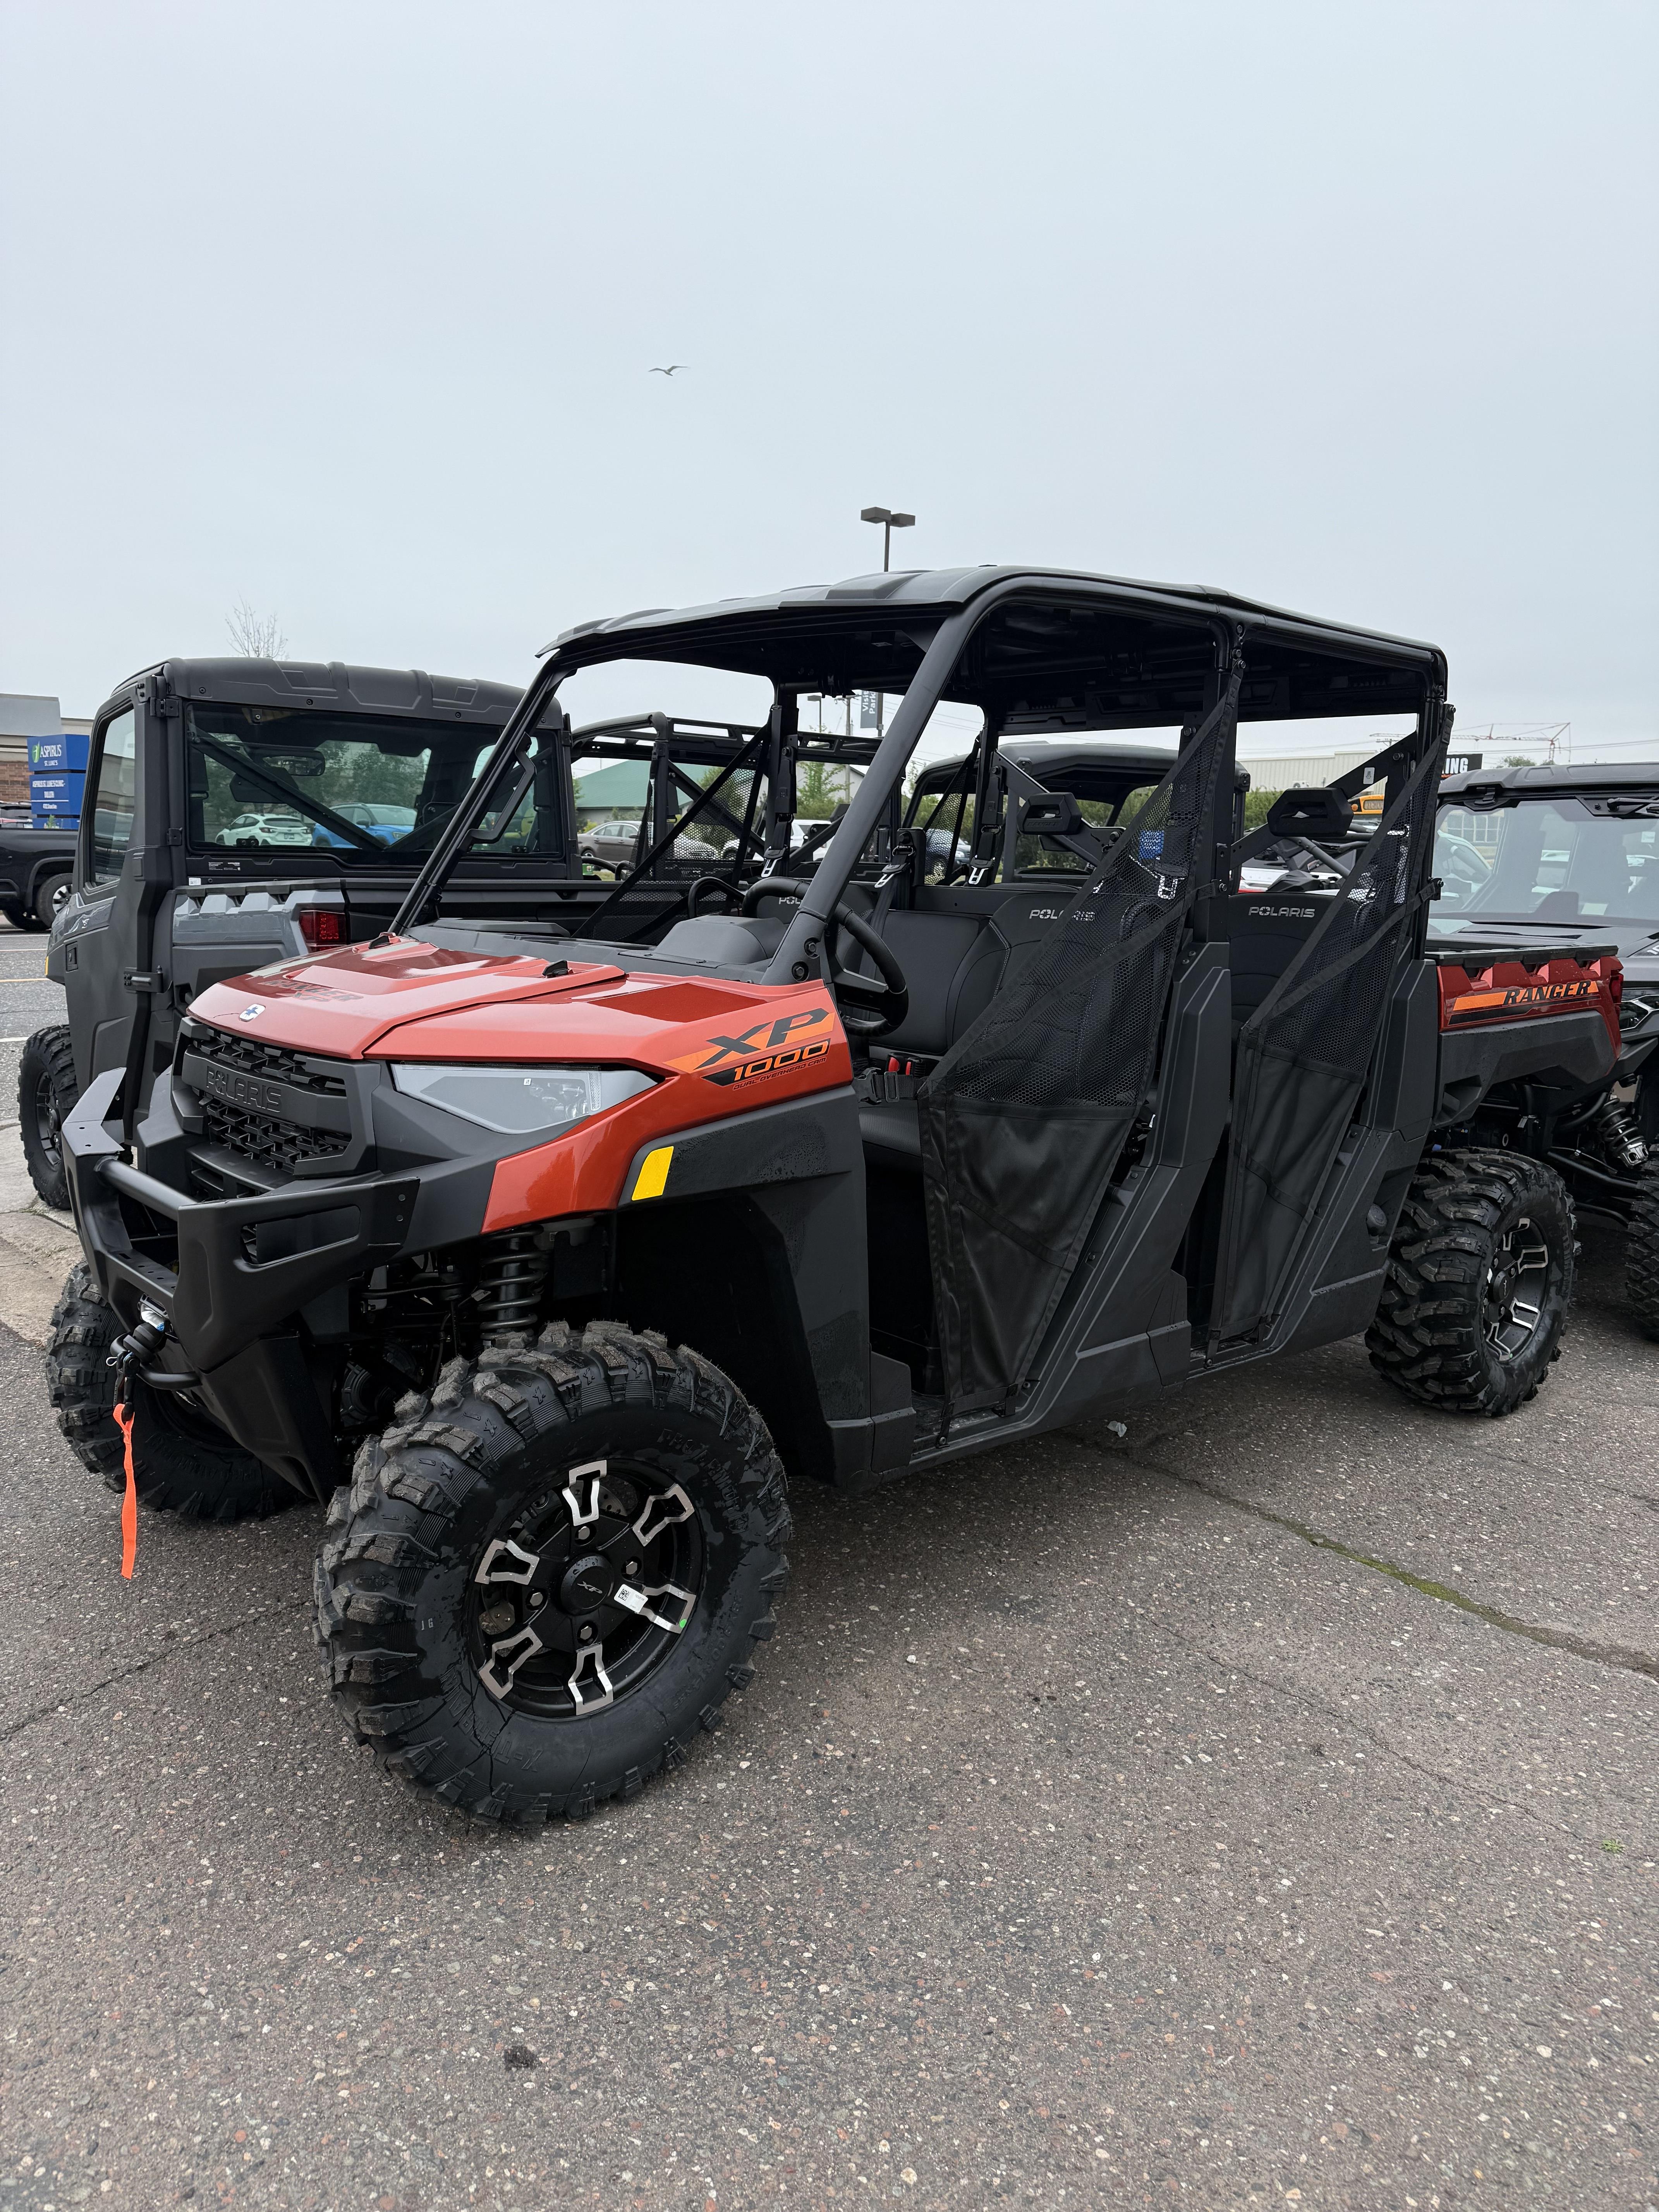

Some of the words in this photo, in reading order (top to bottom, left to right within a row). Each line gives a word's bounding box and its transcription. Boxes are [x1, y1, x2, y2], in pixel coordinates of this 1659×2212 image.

[40, 744, 62, 758] ASPIRUS
[1441, 757, 1469, 774] ING
[778, 896, 801, 905] POL
[1249, 906, 1315, 918] POLARIS
[257, 979, 364, 1002] RANGER
[1502, 980, 1592, 1006] RANGER
[693, 1008, 830, 1070] XP
[734, 1041, 828, 1081] 1000
[733, 1080, 758, 1090] DUAL
[759, 1063, 806, 1082] OVERHEAD
[807, 1057, 826, 1066] CAM
[206, 1066, 282, 1113] POLARIS
[577, 1581, 603, 1594] XP
